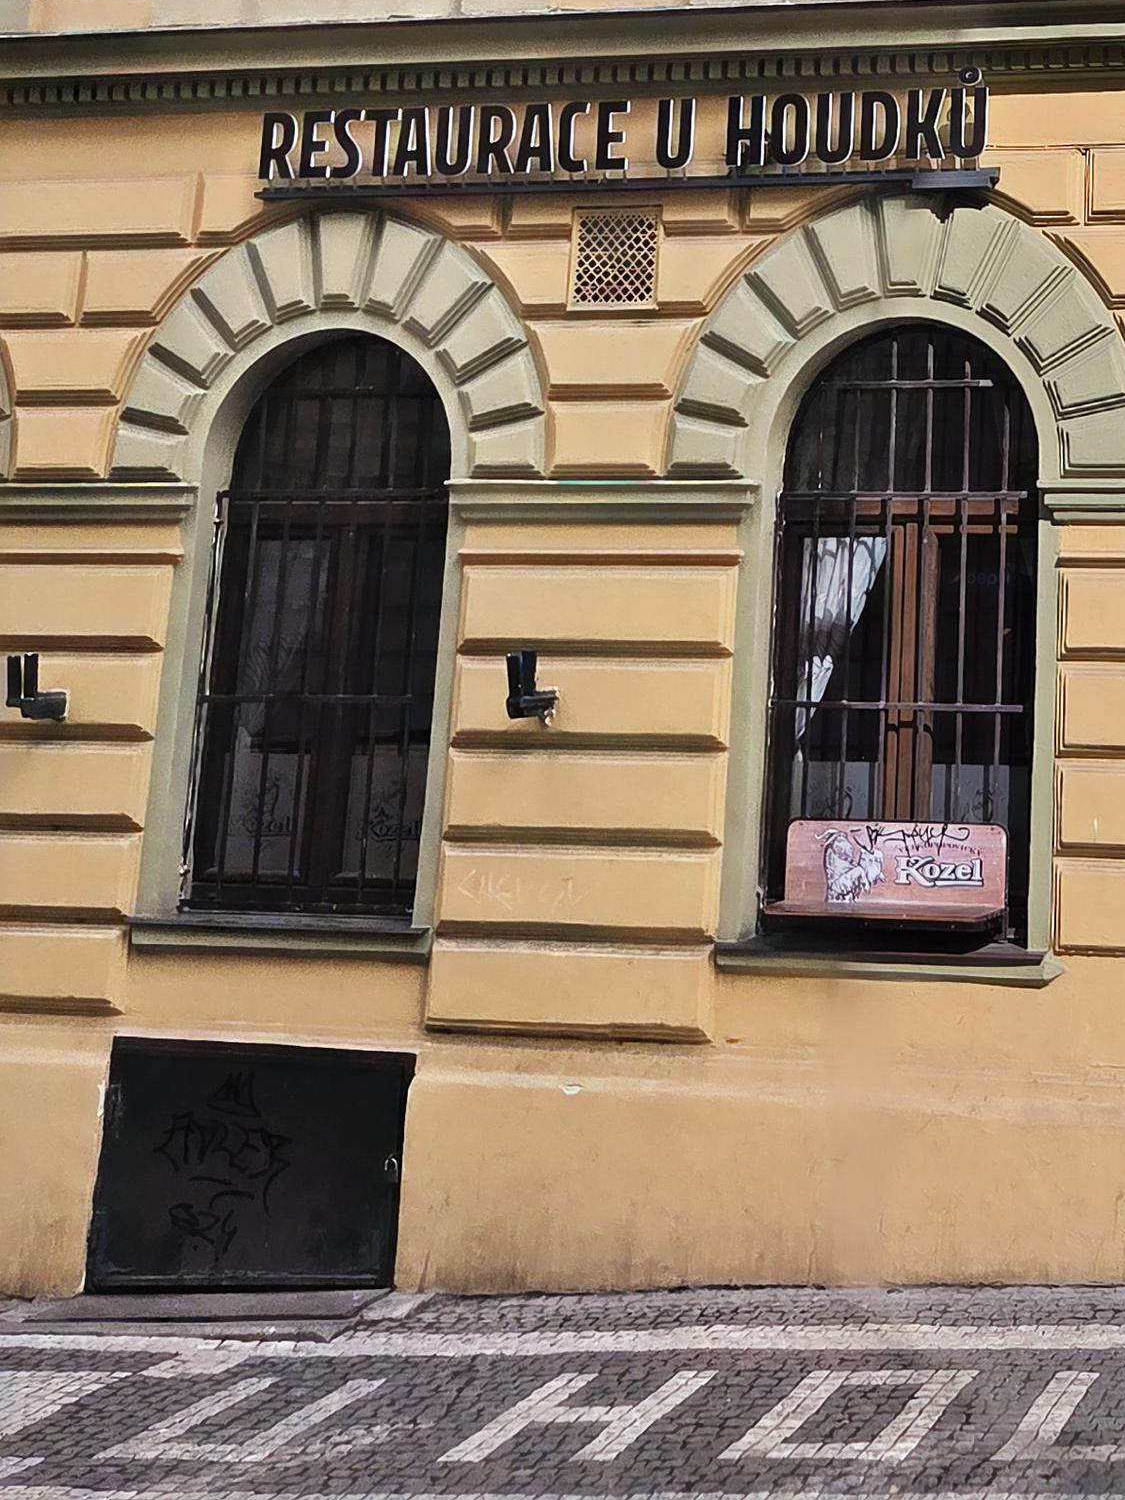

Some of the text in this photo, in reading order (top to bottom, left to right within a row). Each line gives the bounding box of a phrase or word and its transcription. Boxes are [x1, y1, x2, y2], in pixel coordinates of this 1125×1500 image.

[257, 64, 991, 181] RESTAURACE U HOUDKŮ
[894, 855, 985, 888] Kozel
